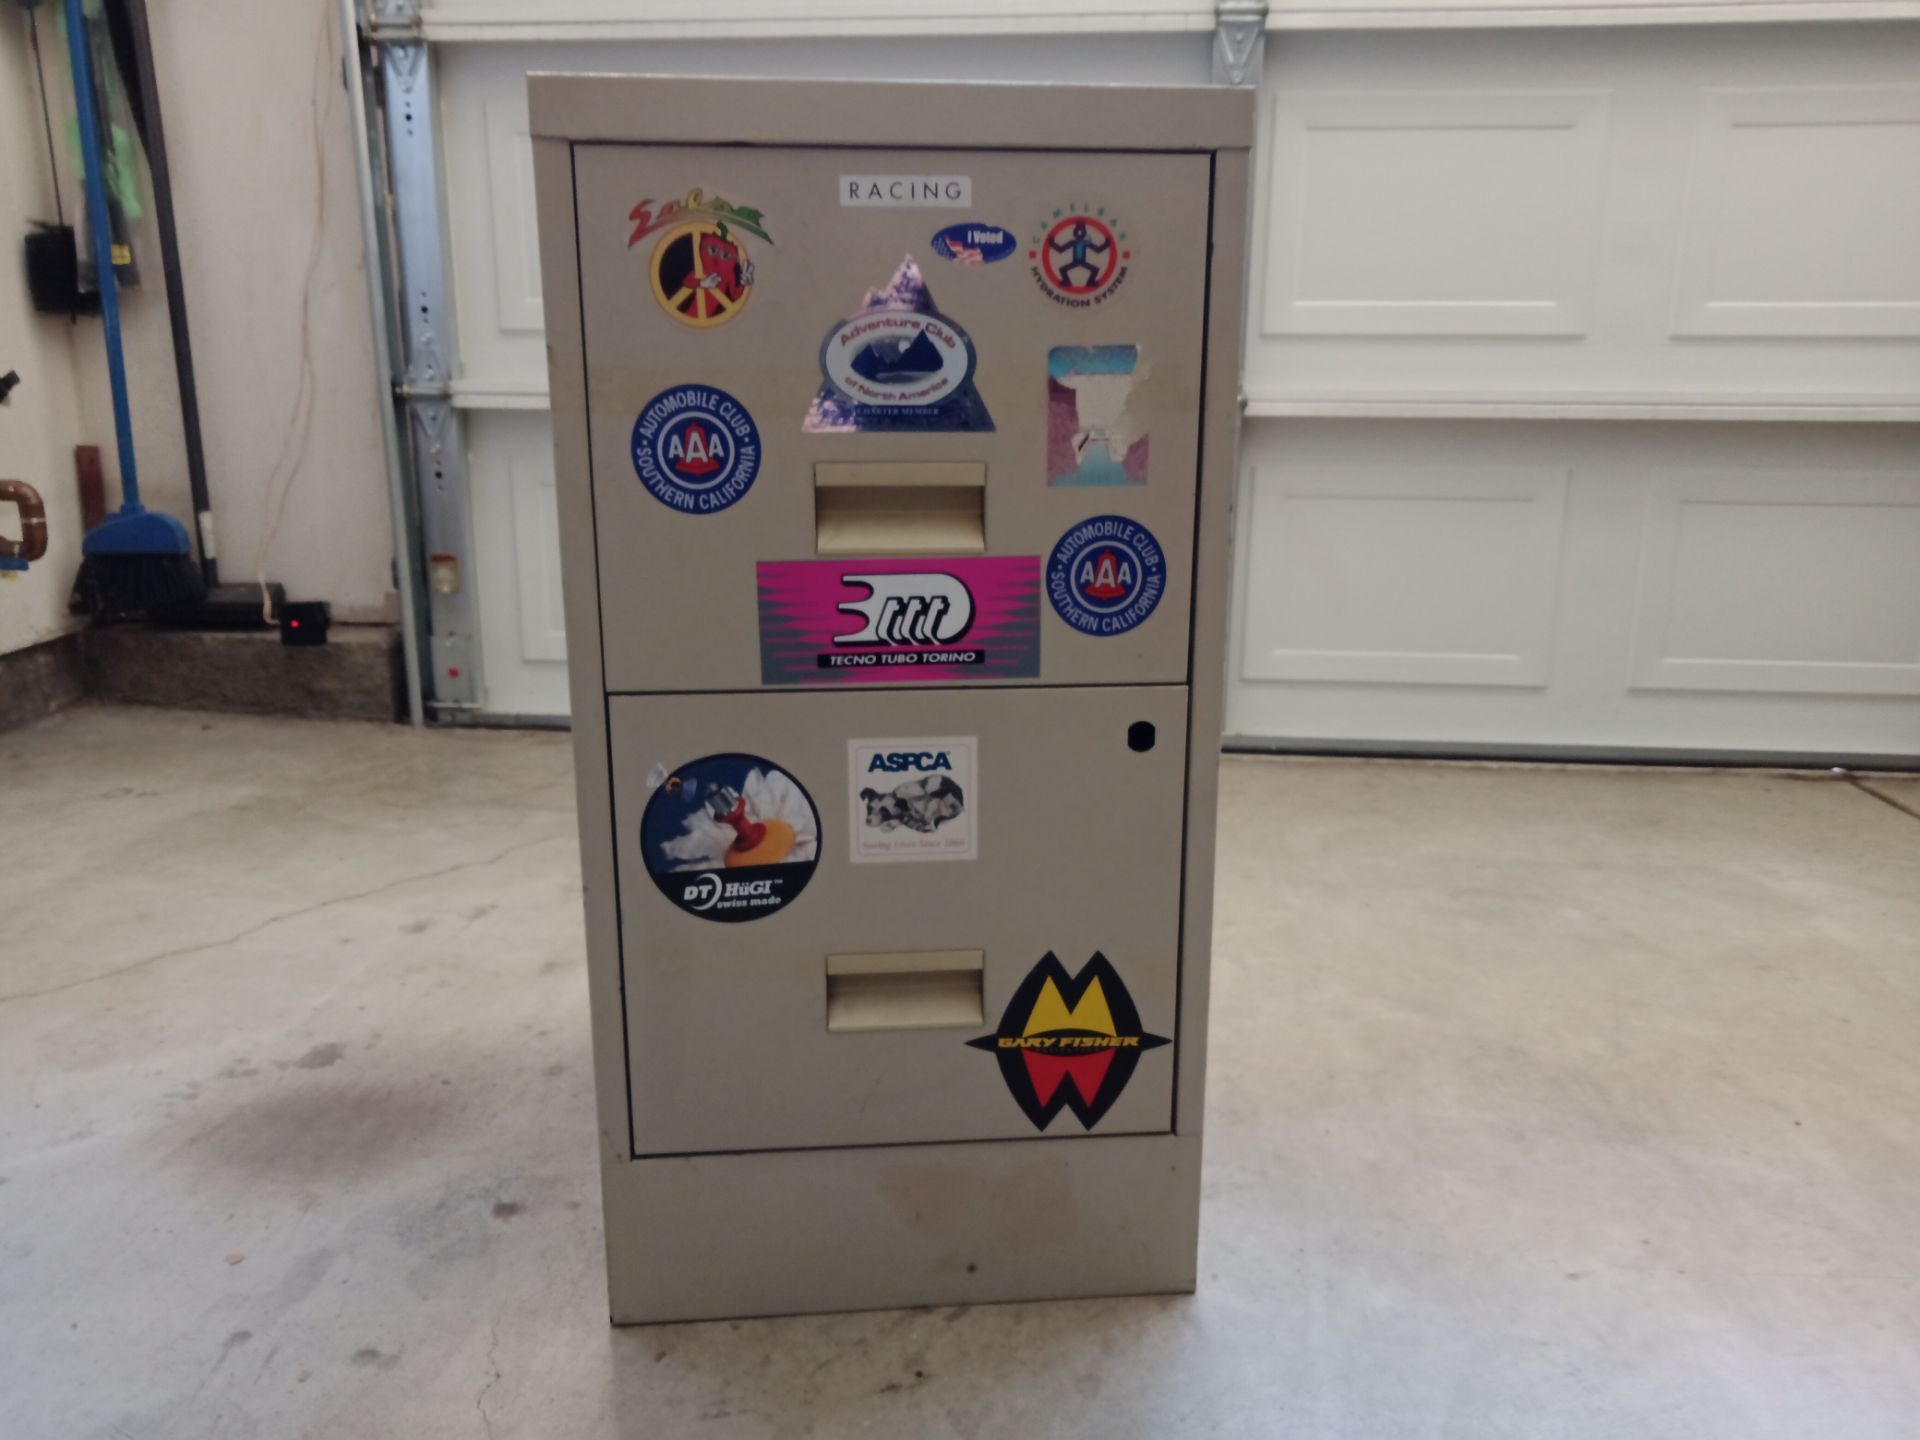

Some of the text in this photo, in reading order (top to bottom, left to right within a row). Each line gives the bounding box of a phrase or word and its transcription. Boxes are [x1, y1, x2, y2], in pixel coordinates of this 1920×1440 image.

[849, 181, 962, 200] RACING
[967, 229, 1003, 245] I Voted
[1031, 265, 1128, 308] HYDRATION SYSTEM
[840, 317, 956, 349] Adventure Club
[844, 376, 949, 401] of North America
[639, 390, 751, 440] AUTOMOBILE CLUB
[668, 431, 725, 463] AAA
[637, 445, 756, 510] SOUTHERN CALIFORNIA
[1057, 521, 1160, 566] AUTOMOBILE CLUB
[1080, 559, 1132, 588] AAA
[1051, 570, 1161, 632] SOUTHERN CALIFORNIA
[830, 651, 976, 666] TECNO TUBO TORINO
[868, 751, 952, 773] ASPCA
[683, 884, 713, 901] DT
[717, 896, 782, 910] swiss made
[997, 1036, 1140, 1048] GARY FISHER
